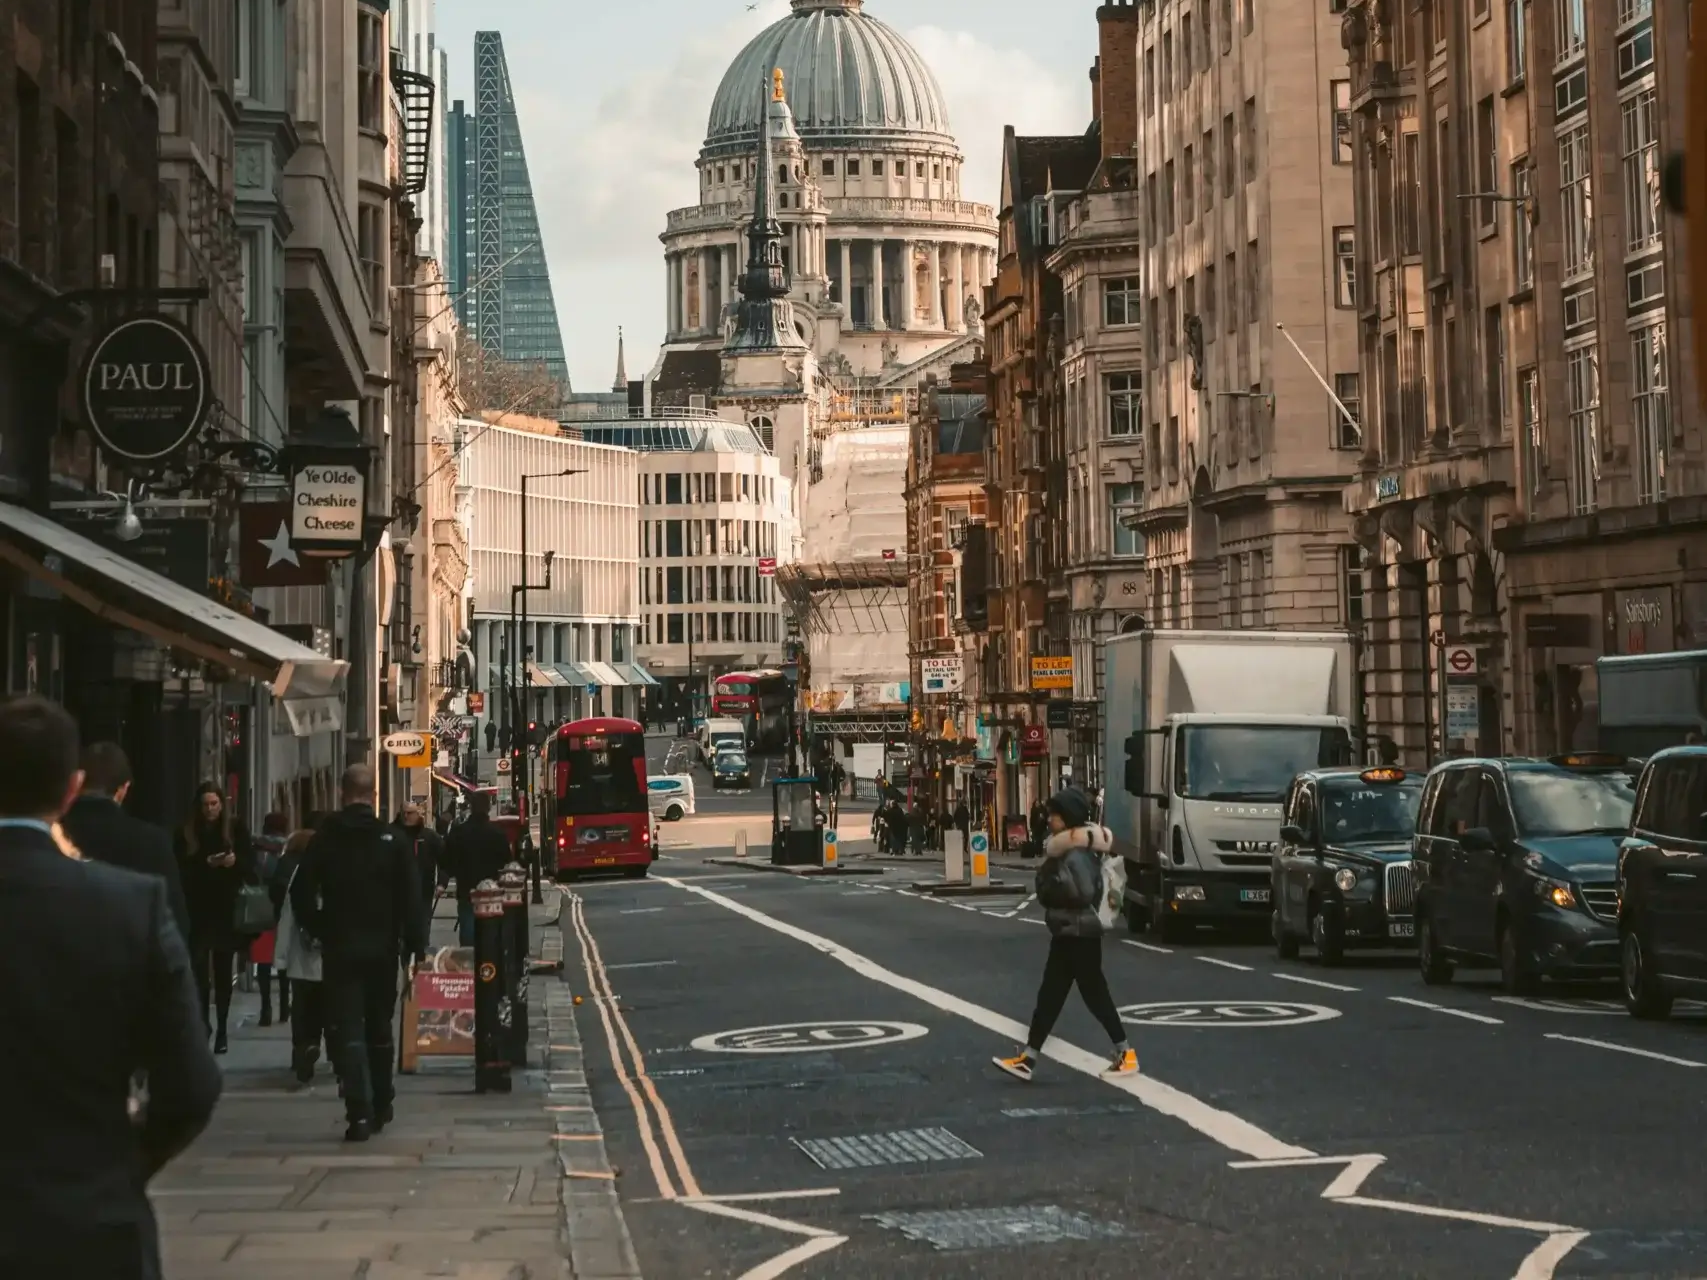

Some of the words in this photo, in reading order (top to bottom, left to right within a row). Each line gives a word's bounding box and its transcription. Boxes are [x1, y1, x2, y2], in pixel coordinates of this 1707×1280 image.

[100, 362, 194, 391] PAUL
[305, 469, 320, 484] Ye
[322, 470, 356, 485] Olde
[297, 492, 357, 508] Cheshire
[304, 515, 356, 530] Cheese
[1122, 581, 1137, 595] 88
[1625, 596, 1662, 628] Sainsbury's
[1434, 631, 1446, 645] H
[941, 659, 959, 667] LET
[1051, 661, 1069, 669] LET
[395, 739, 422, 747] JEEVES
[1133, 1006, 1298, 1020] 20
[732, 1026, 885, 1048] 20
